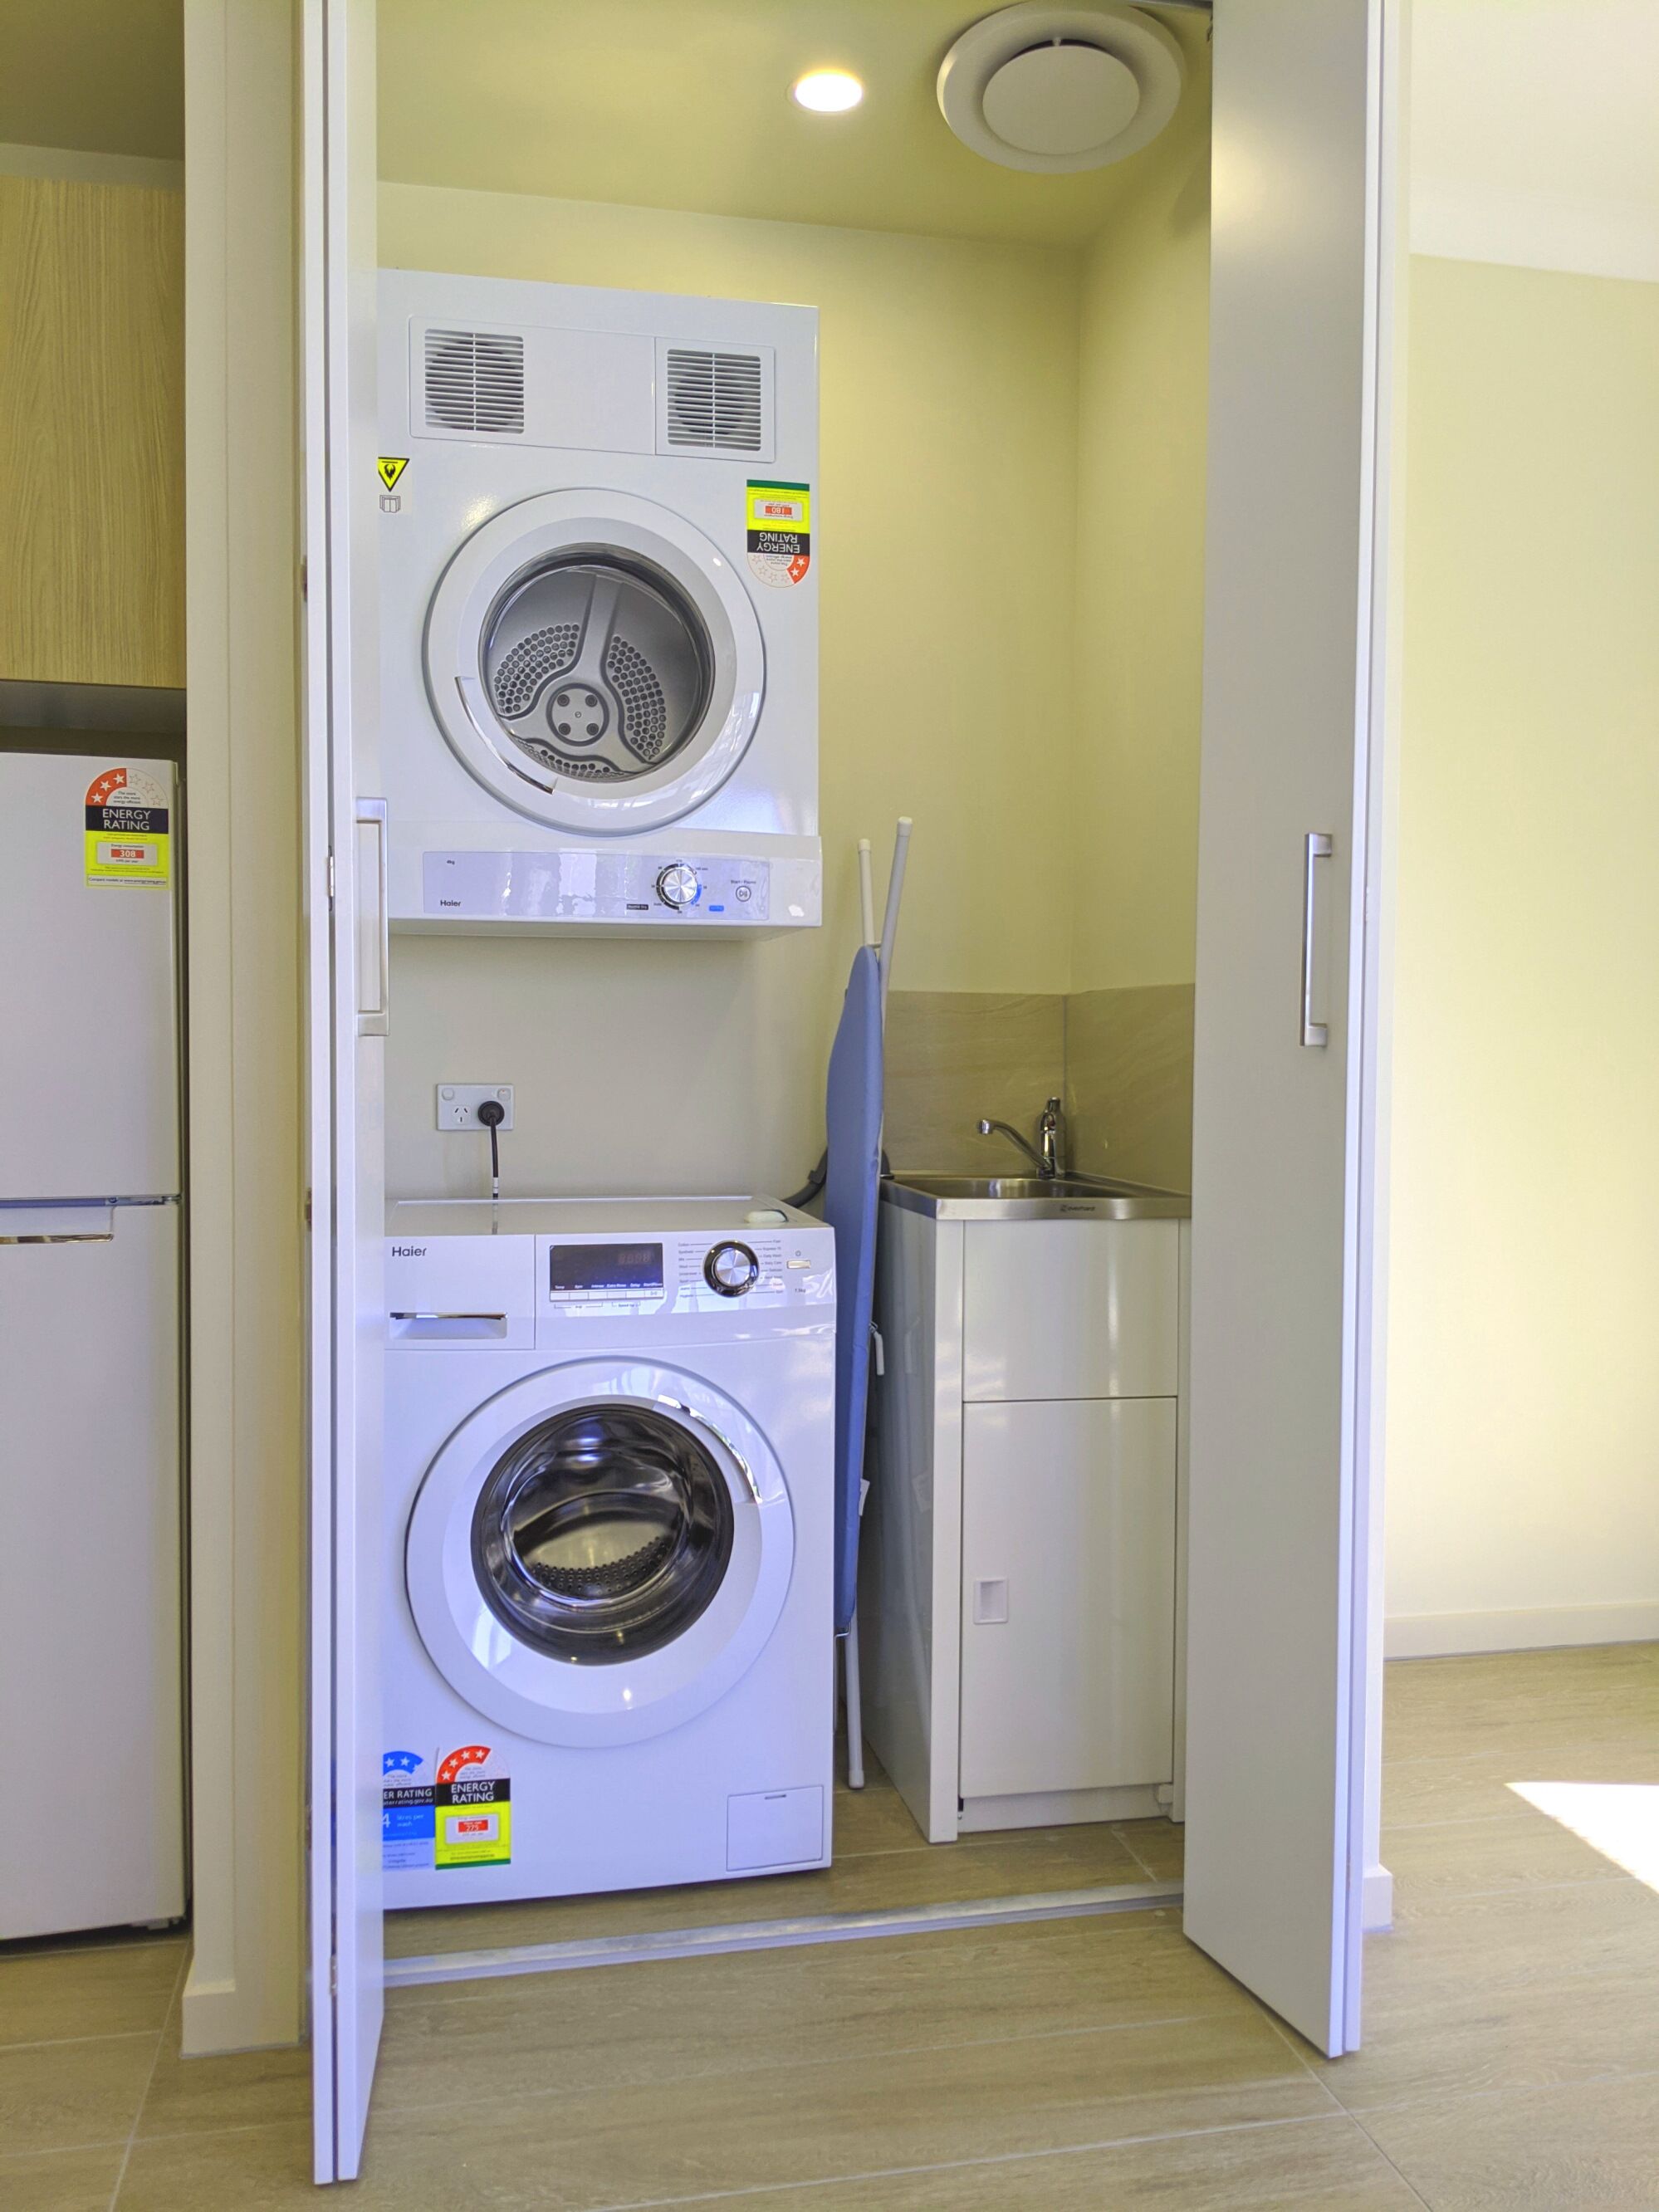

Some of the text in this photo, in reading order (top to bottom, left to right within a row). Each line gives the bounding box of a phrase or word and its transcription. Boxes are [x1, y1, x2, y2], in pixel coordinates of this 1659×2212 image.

[759, 532, 797, 543] RATING
[756, 542, 800, 553] ENERGY
[103, 809, 151, 820] ENERGY
[104, 820, 149, 830] RATING
[392, 1245, 427, 1256] Haier
[451, 1781, 495, 1794] ENERGY
[397, 1789, 432, 1798] RATING
[452, 1792, 494, 1803] RATING
